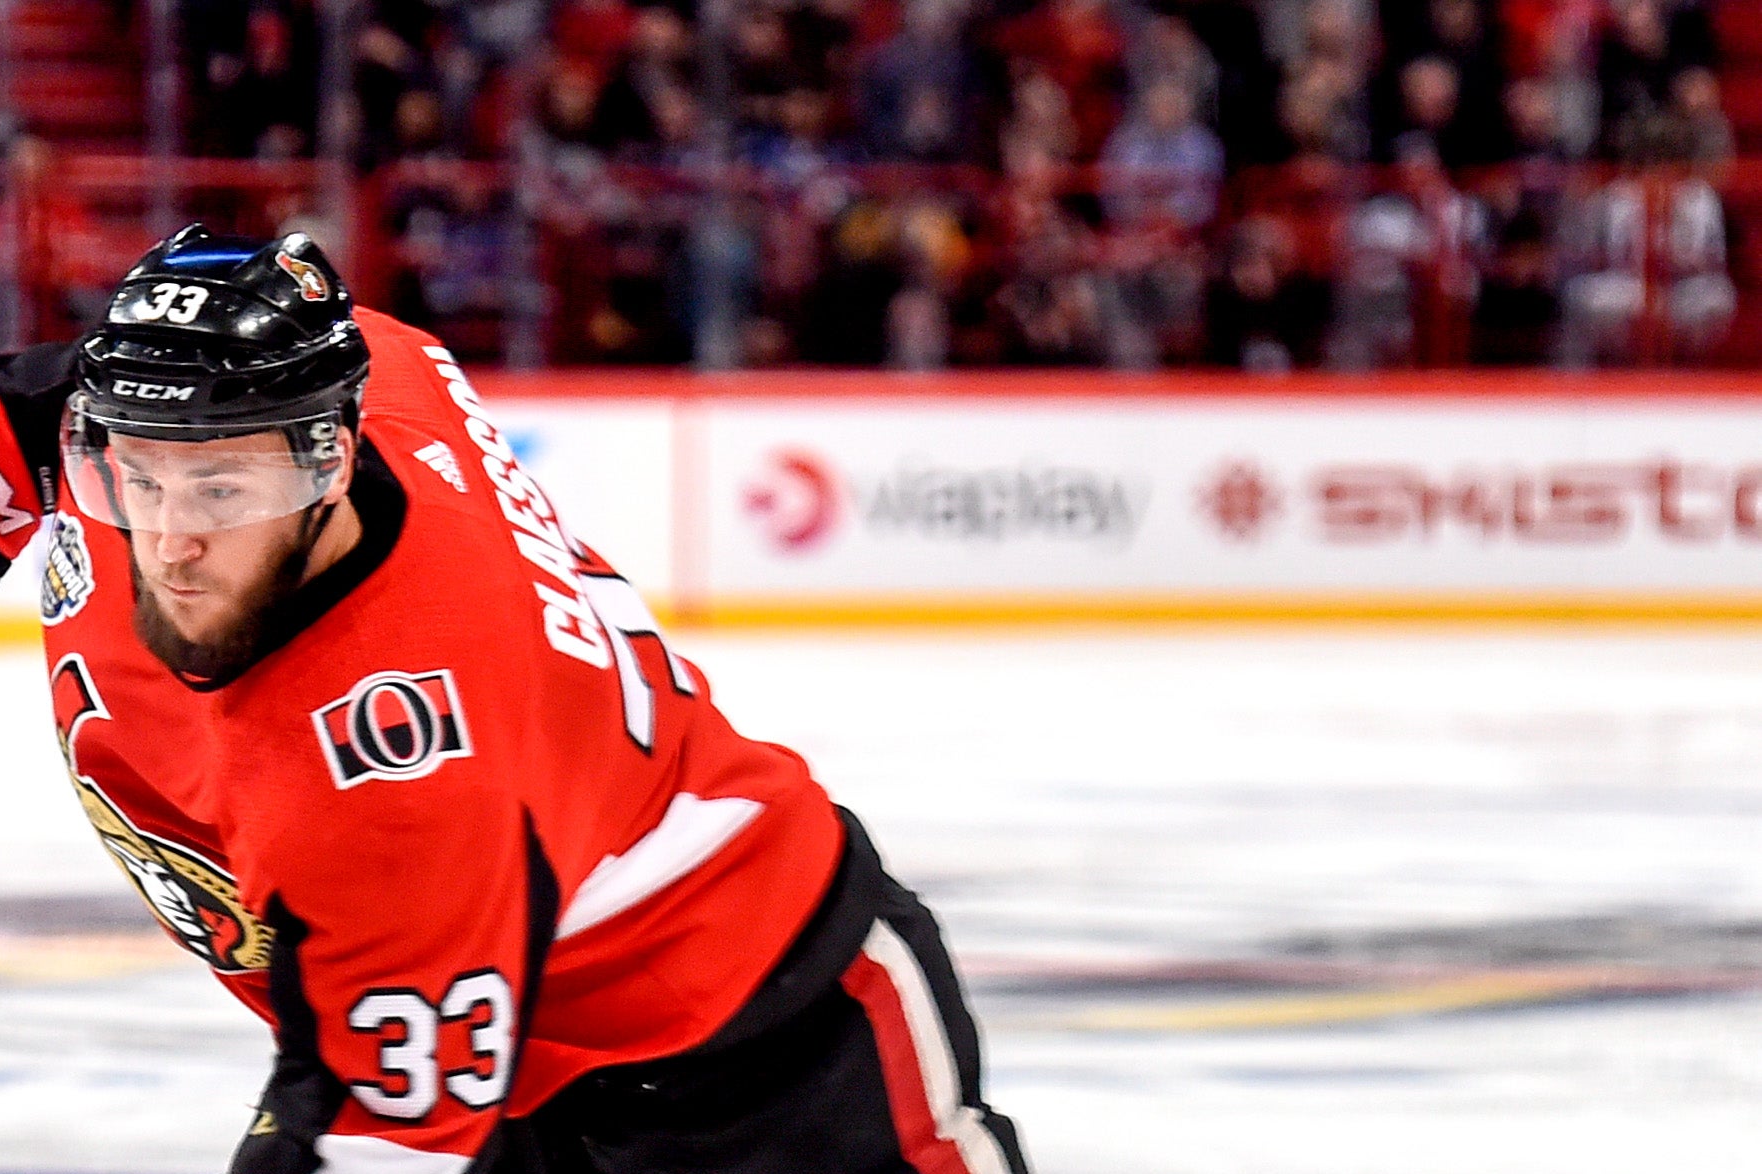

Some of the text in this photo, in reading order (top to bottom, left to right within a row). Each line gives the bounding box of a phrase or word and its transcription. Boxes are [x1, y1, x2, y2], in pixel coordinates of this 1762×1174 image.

[137, 283, 210, 324] 33
[112, 379, 195, 401] CCM
[347, 966, 516, 1124] 33
